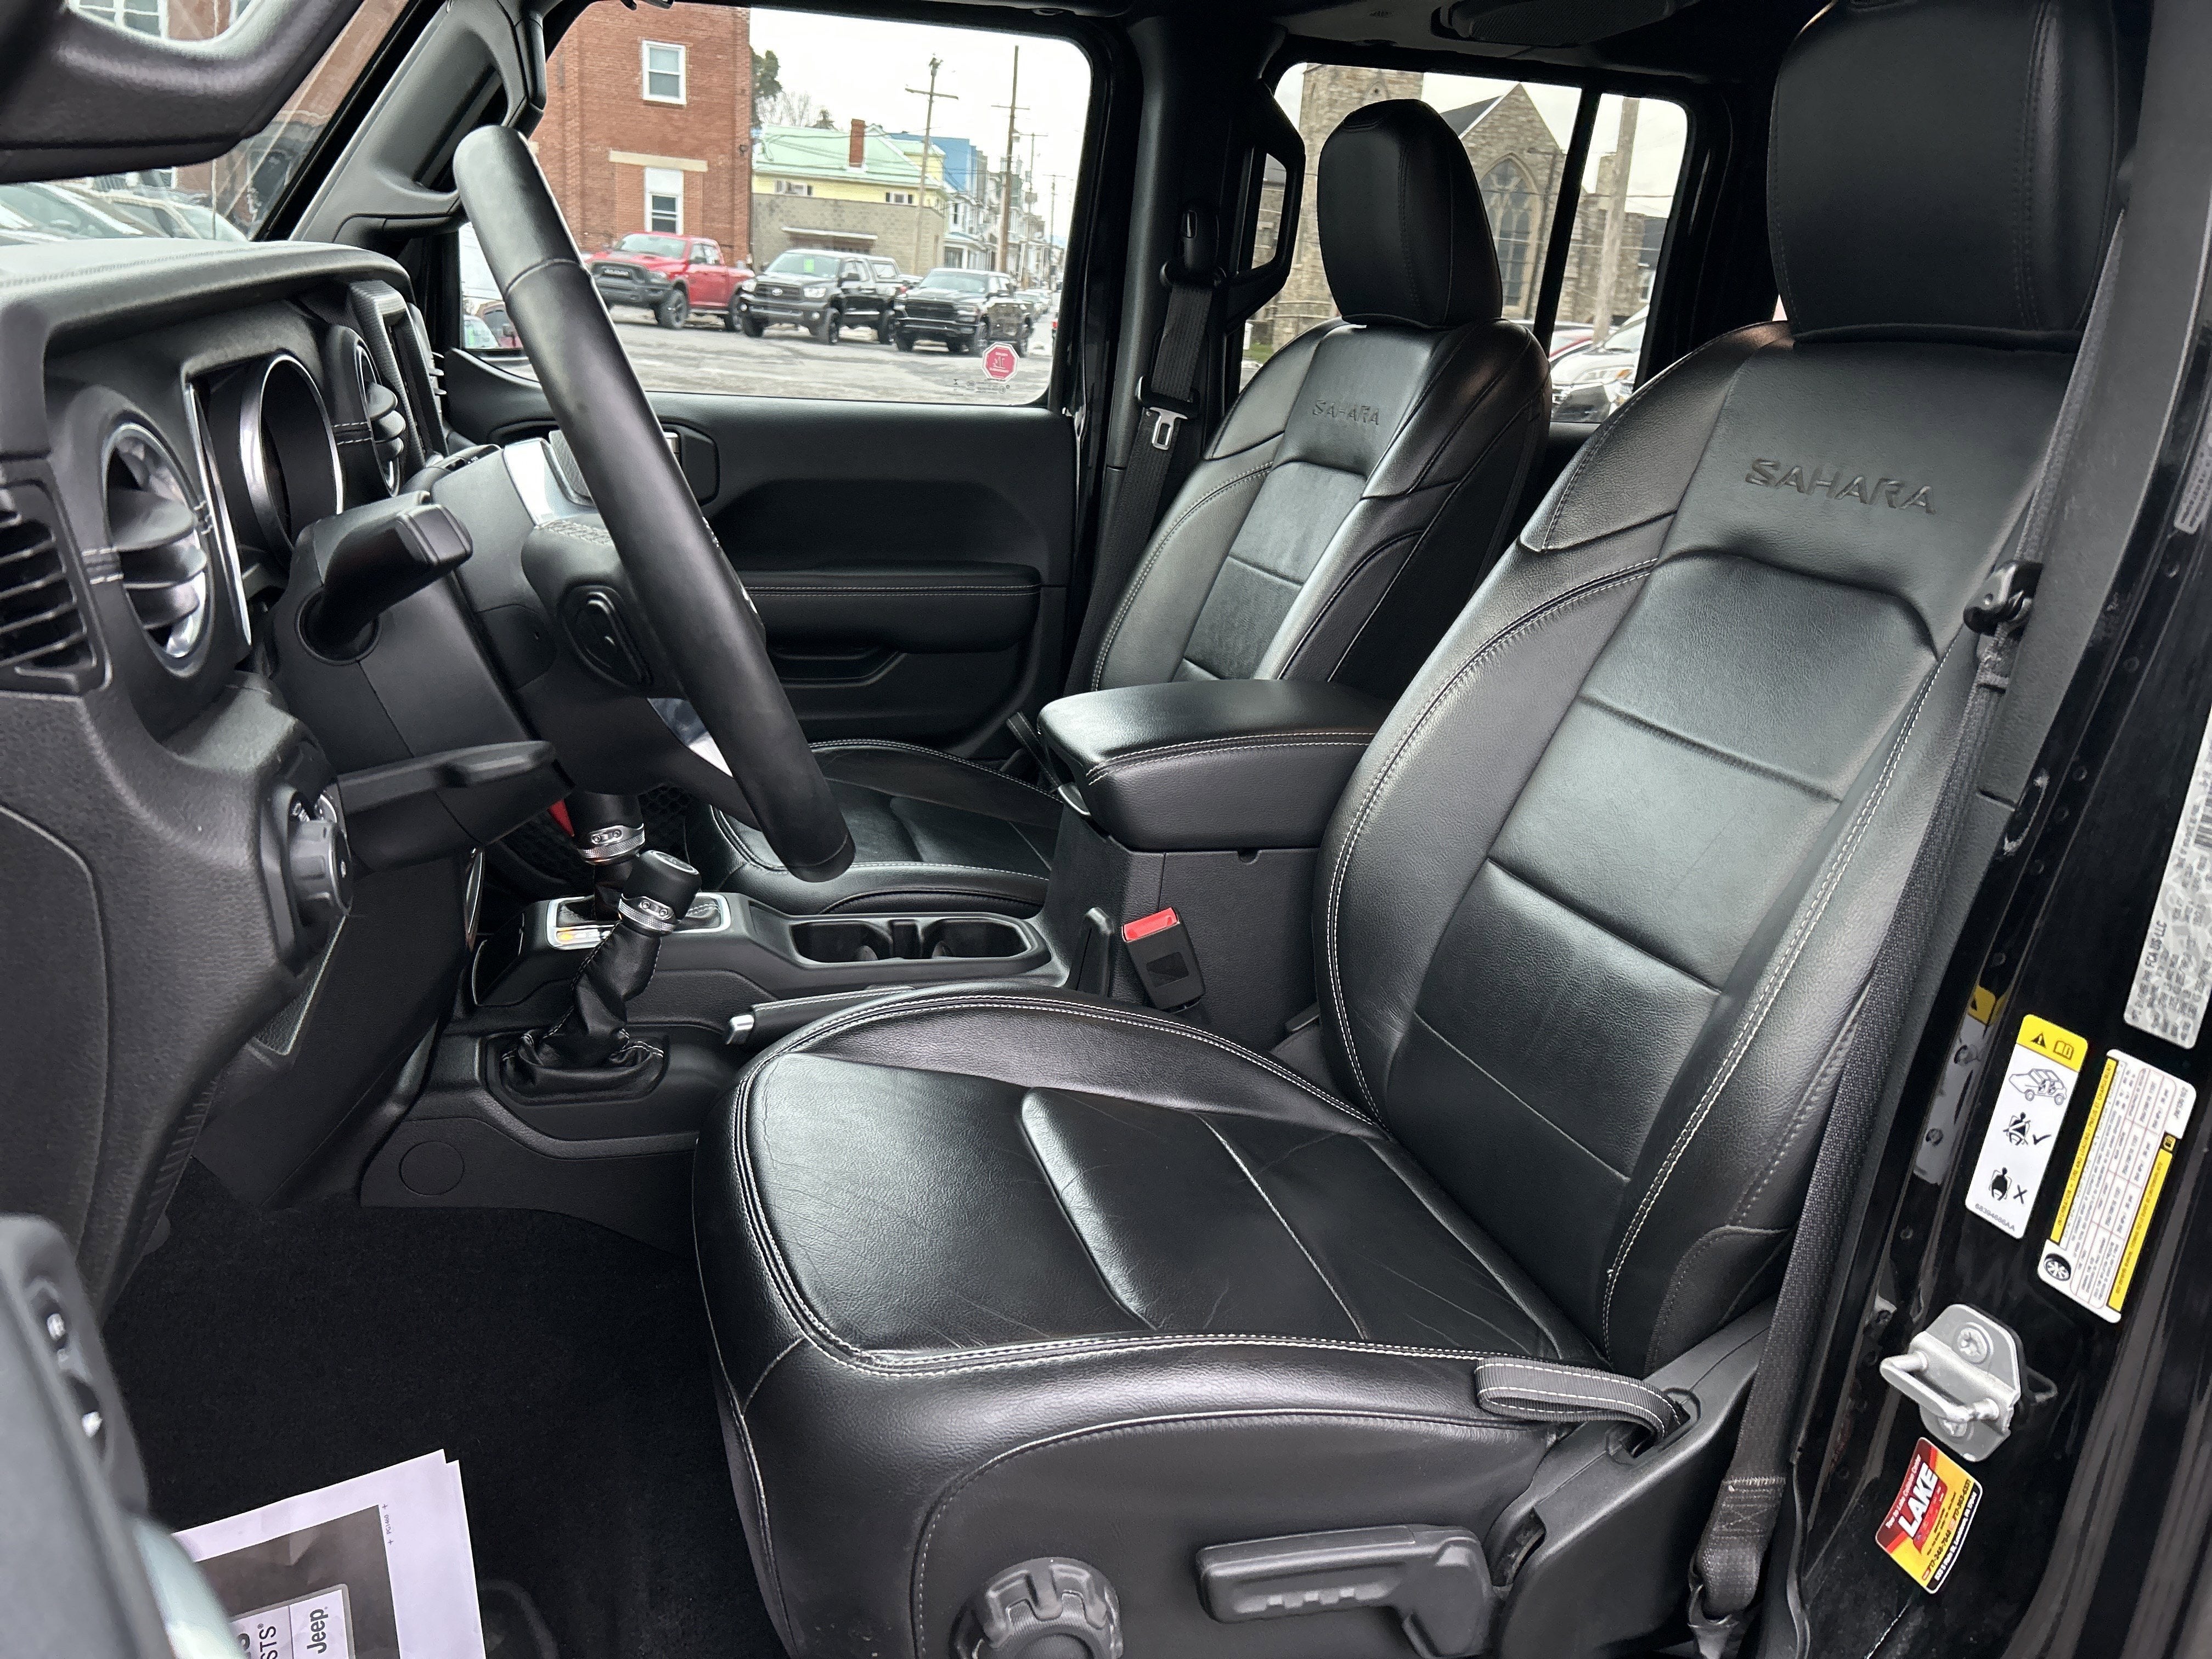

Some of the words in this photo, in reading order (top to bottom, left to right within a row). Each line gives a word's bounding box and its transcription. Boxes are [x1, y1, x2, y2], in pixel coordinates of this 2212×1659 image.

[1313, 399, 1380, 426] SAHARA
[1745, 458, 1936, 514] SAHARA
[2154, 920, 2168, 938] LLC
[2150, 938, 2162, 951] US
[2145, 951, 2158, 968] FCA
[1898, 1462, 1938, 1538] LAKE
[306, 1609, 329, 1654] Jeep
